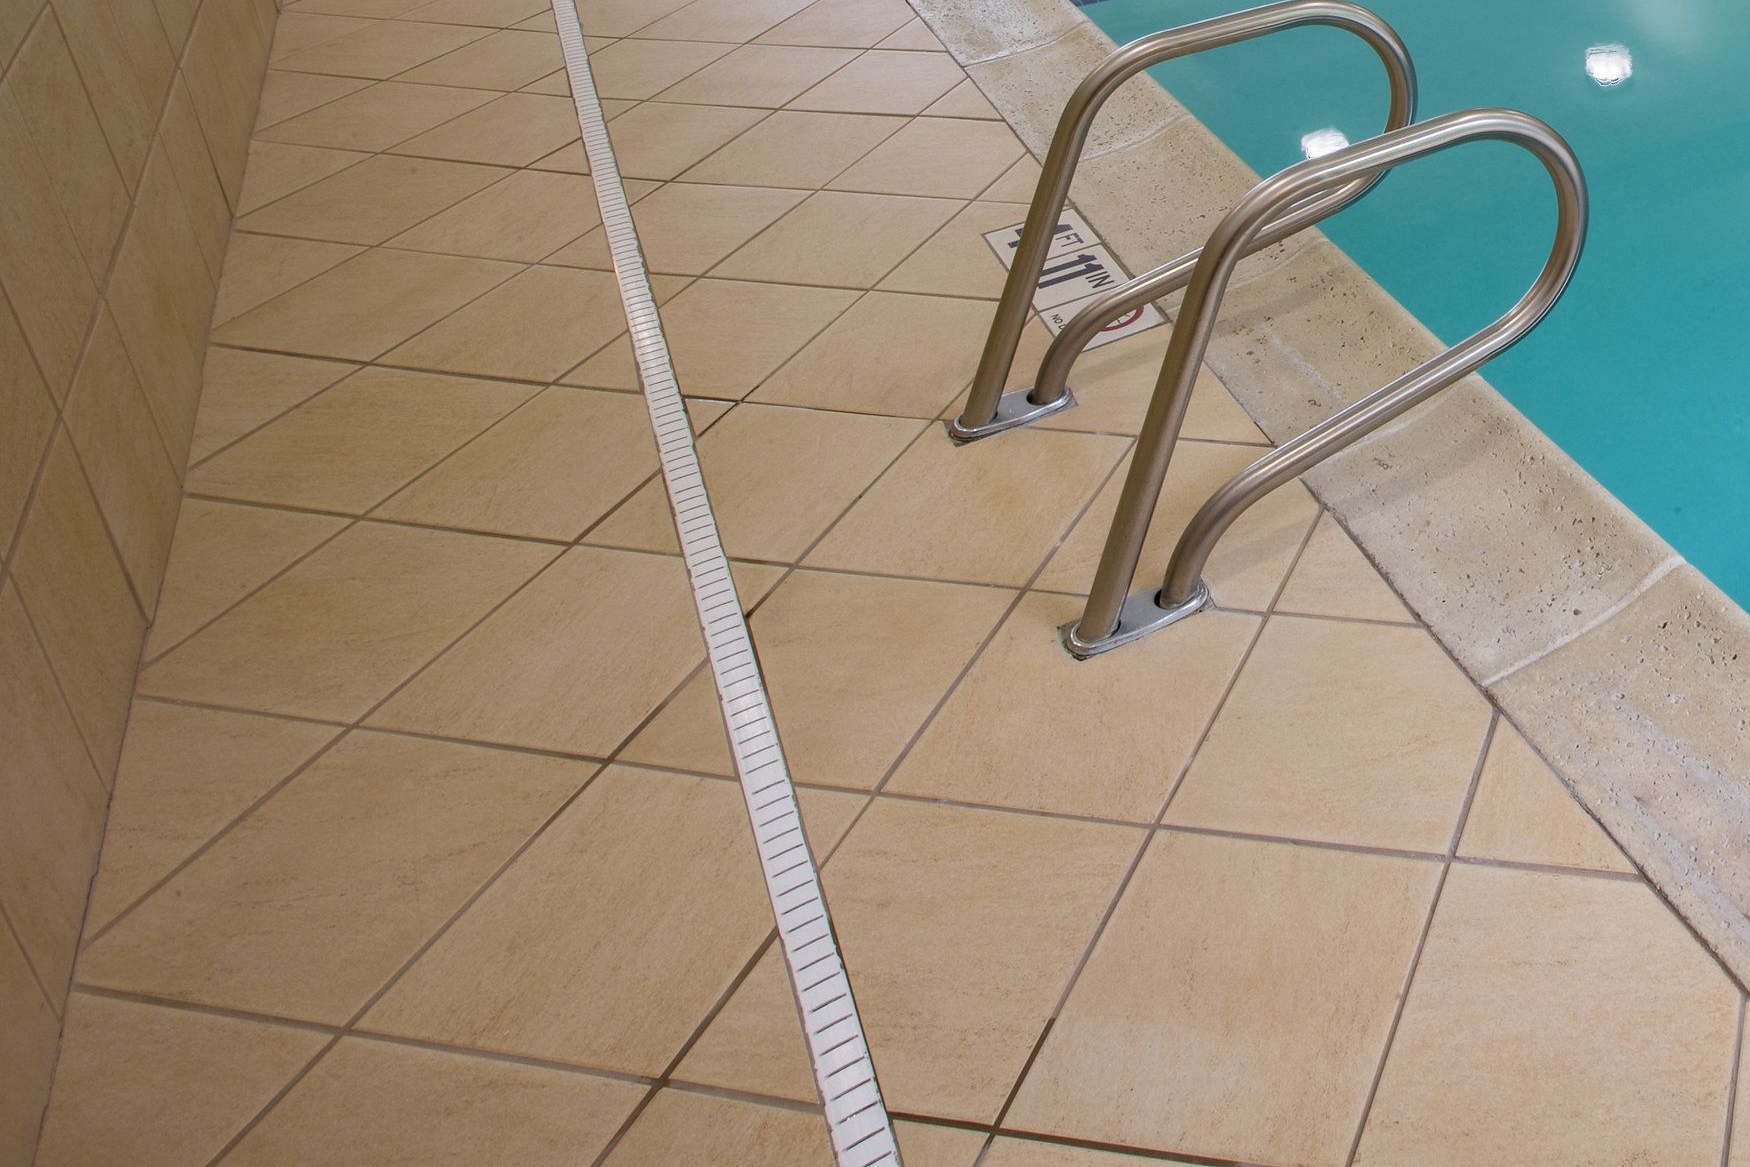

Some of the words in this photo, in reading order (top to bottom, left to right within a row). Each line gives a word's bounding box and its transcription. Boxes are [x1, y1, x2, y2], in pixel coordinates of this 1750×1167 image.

[1056, 232, 1084, 248] FT
[1038, 254, 1104, 289] 11
[1085, 271, 1115, 289] IN
